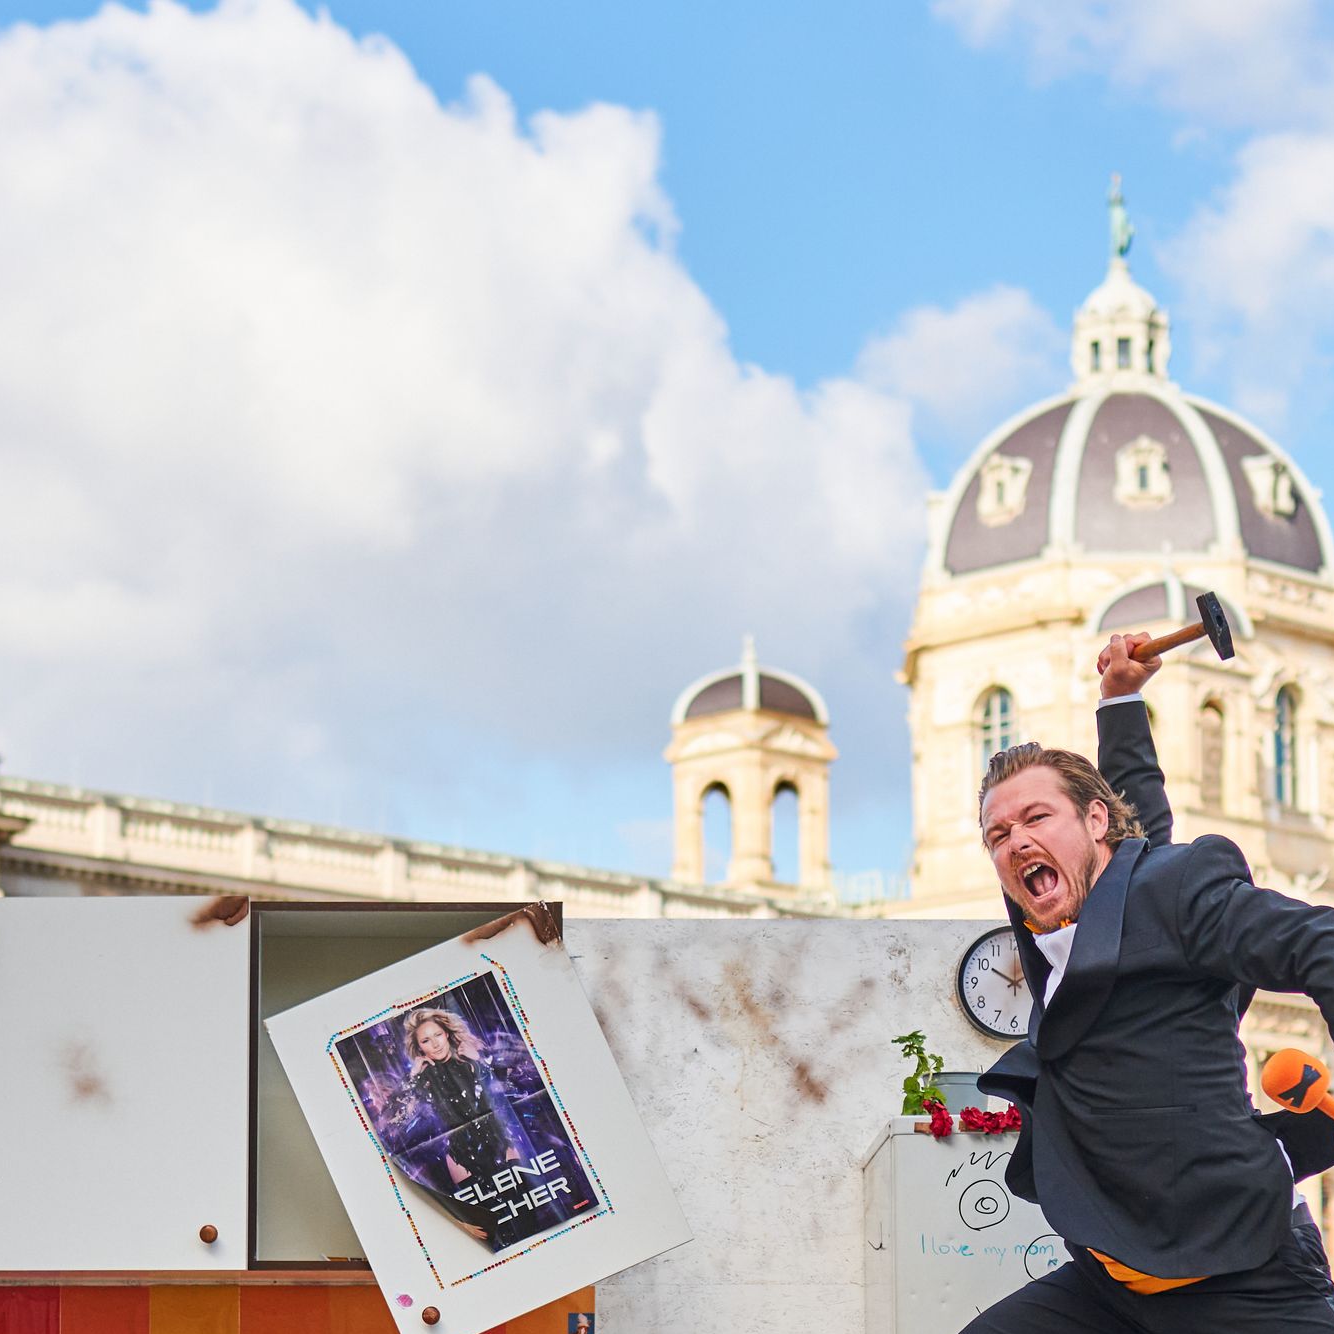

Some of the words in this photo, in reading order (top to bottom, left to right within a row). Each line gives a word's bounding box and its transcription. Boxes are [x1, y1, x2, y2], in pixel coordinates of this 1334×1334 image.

[977, 958, 990, 971] 10
[970, 976, 979, 989] 9
[977, 995, 986, 1009] 8
[994, 1010, 1002, 1023] 7
[1010, 1015, 1019, 1029] 6
[983, 1246, 1007, 1266] my
[1014, 1240, 1055, 1257] mom
